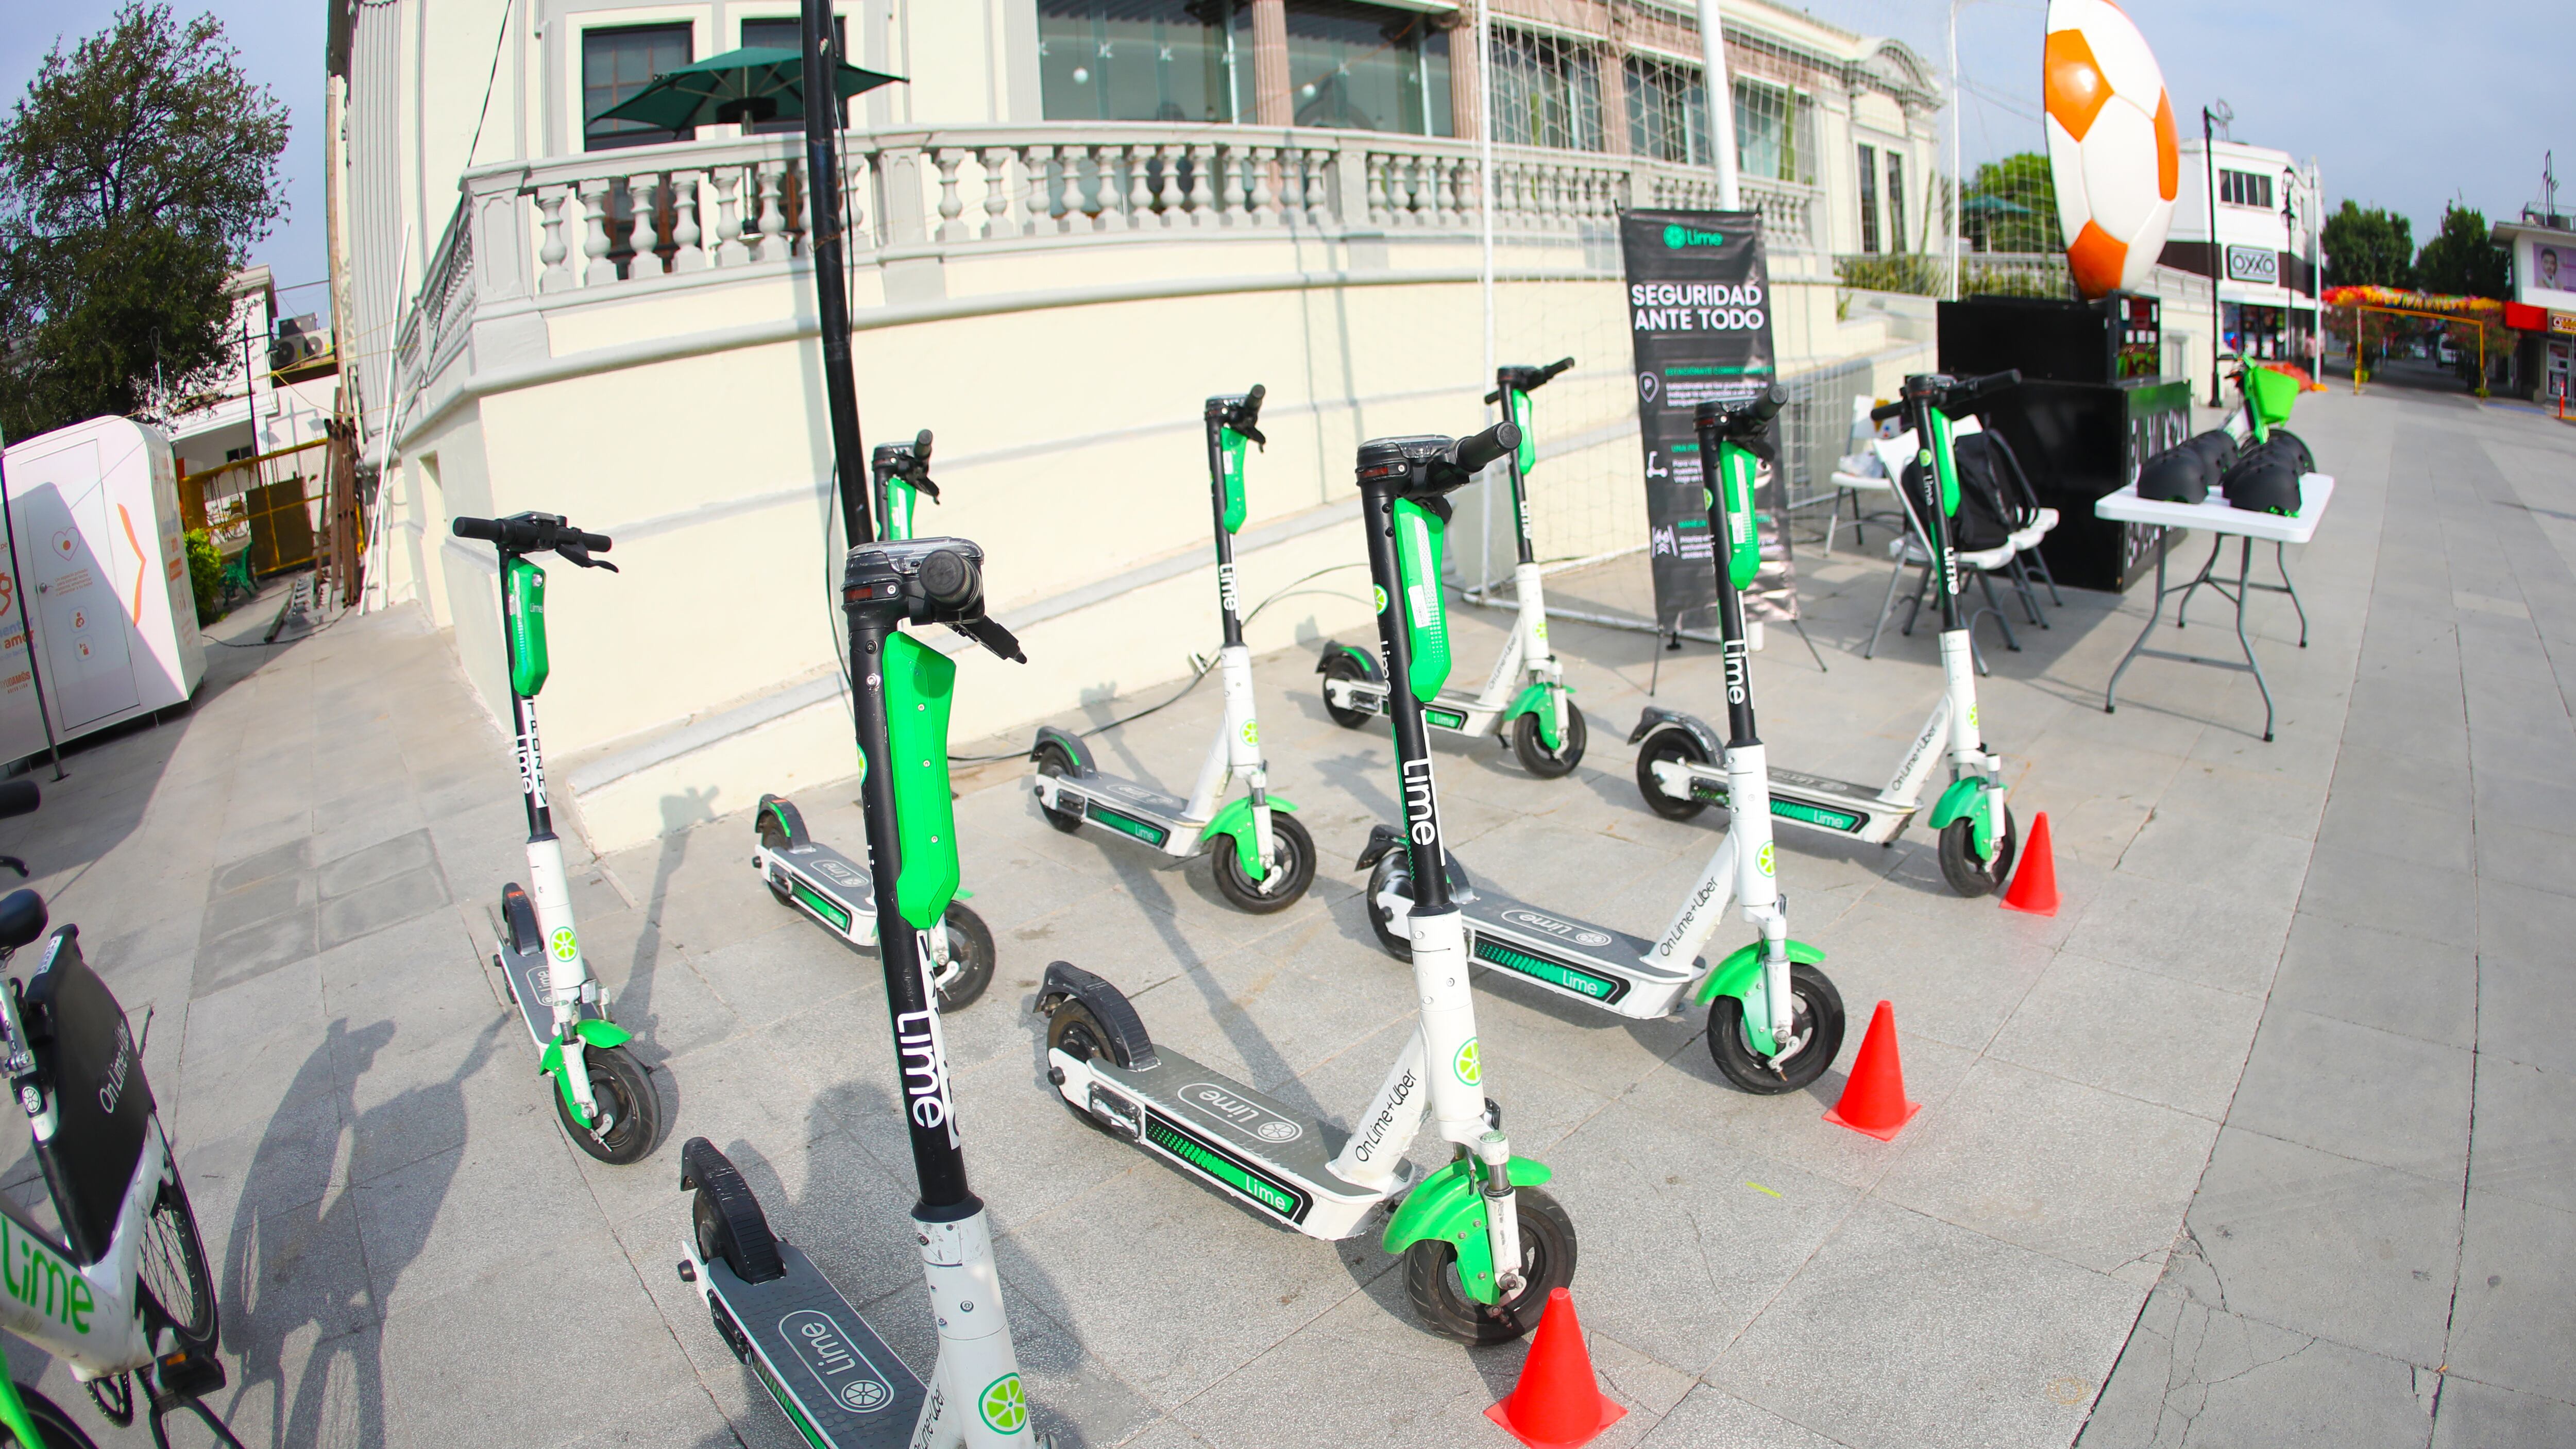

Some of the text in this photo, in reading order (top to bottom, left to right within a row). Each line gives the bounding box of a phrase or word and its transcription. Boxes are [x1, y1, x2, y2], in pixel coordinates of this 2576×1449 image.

[1686, 229, 1723, 246] Lime
[2233, 254, 2274, 274] OXXO
[1631, 284, 1762, 306] SEGURIDAD
[1635, 308, 1764, 330] ANTE TODO
[1943, 547, 1960, 595] Lime
[1219, 563, 1236, 611] Lime
[1724, 639, 1745, 704] Lime
[1434, 713, 1455, 727] Lime
[1403, 758, 1436, 845] Lime
[1814, 810, 1843, 828] Lime
[1135, 824, 1154, 841] Lime
[828, 906, 844, 928] Lime
[1519, 913, 1573, 935] Lime
[1659, 941, 1676, 957] On
[1563, 969, 1598, 996] Lime
[897, 1010, 944, 1128] Lime
[99, 1083, 119, 1114] On
[1199, 1090, 1259, 1122] Lime
[1355, 1140, 1375, 1162] On
[1246, 1175, 1286, 1211] Lime
[1, 1213, 94, 1334] Lime
[801, 1322, 856, 1375] Lime
